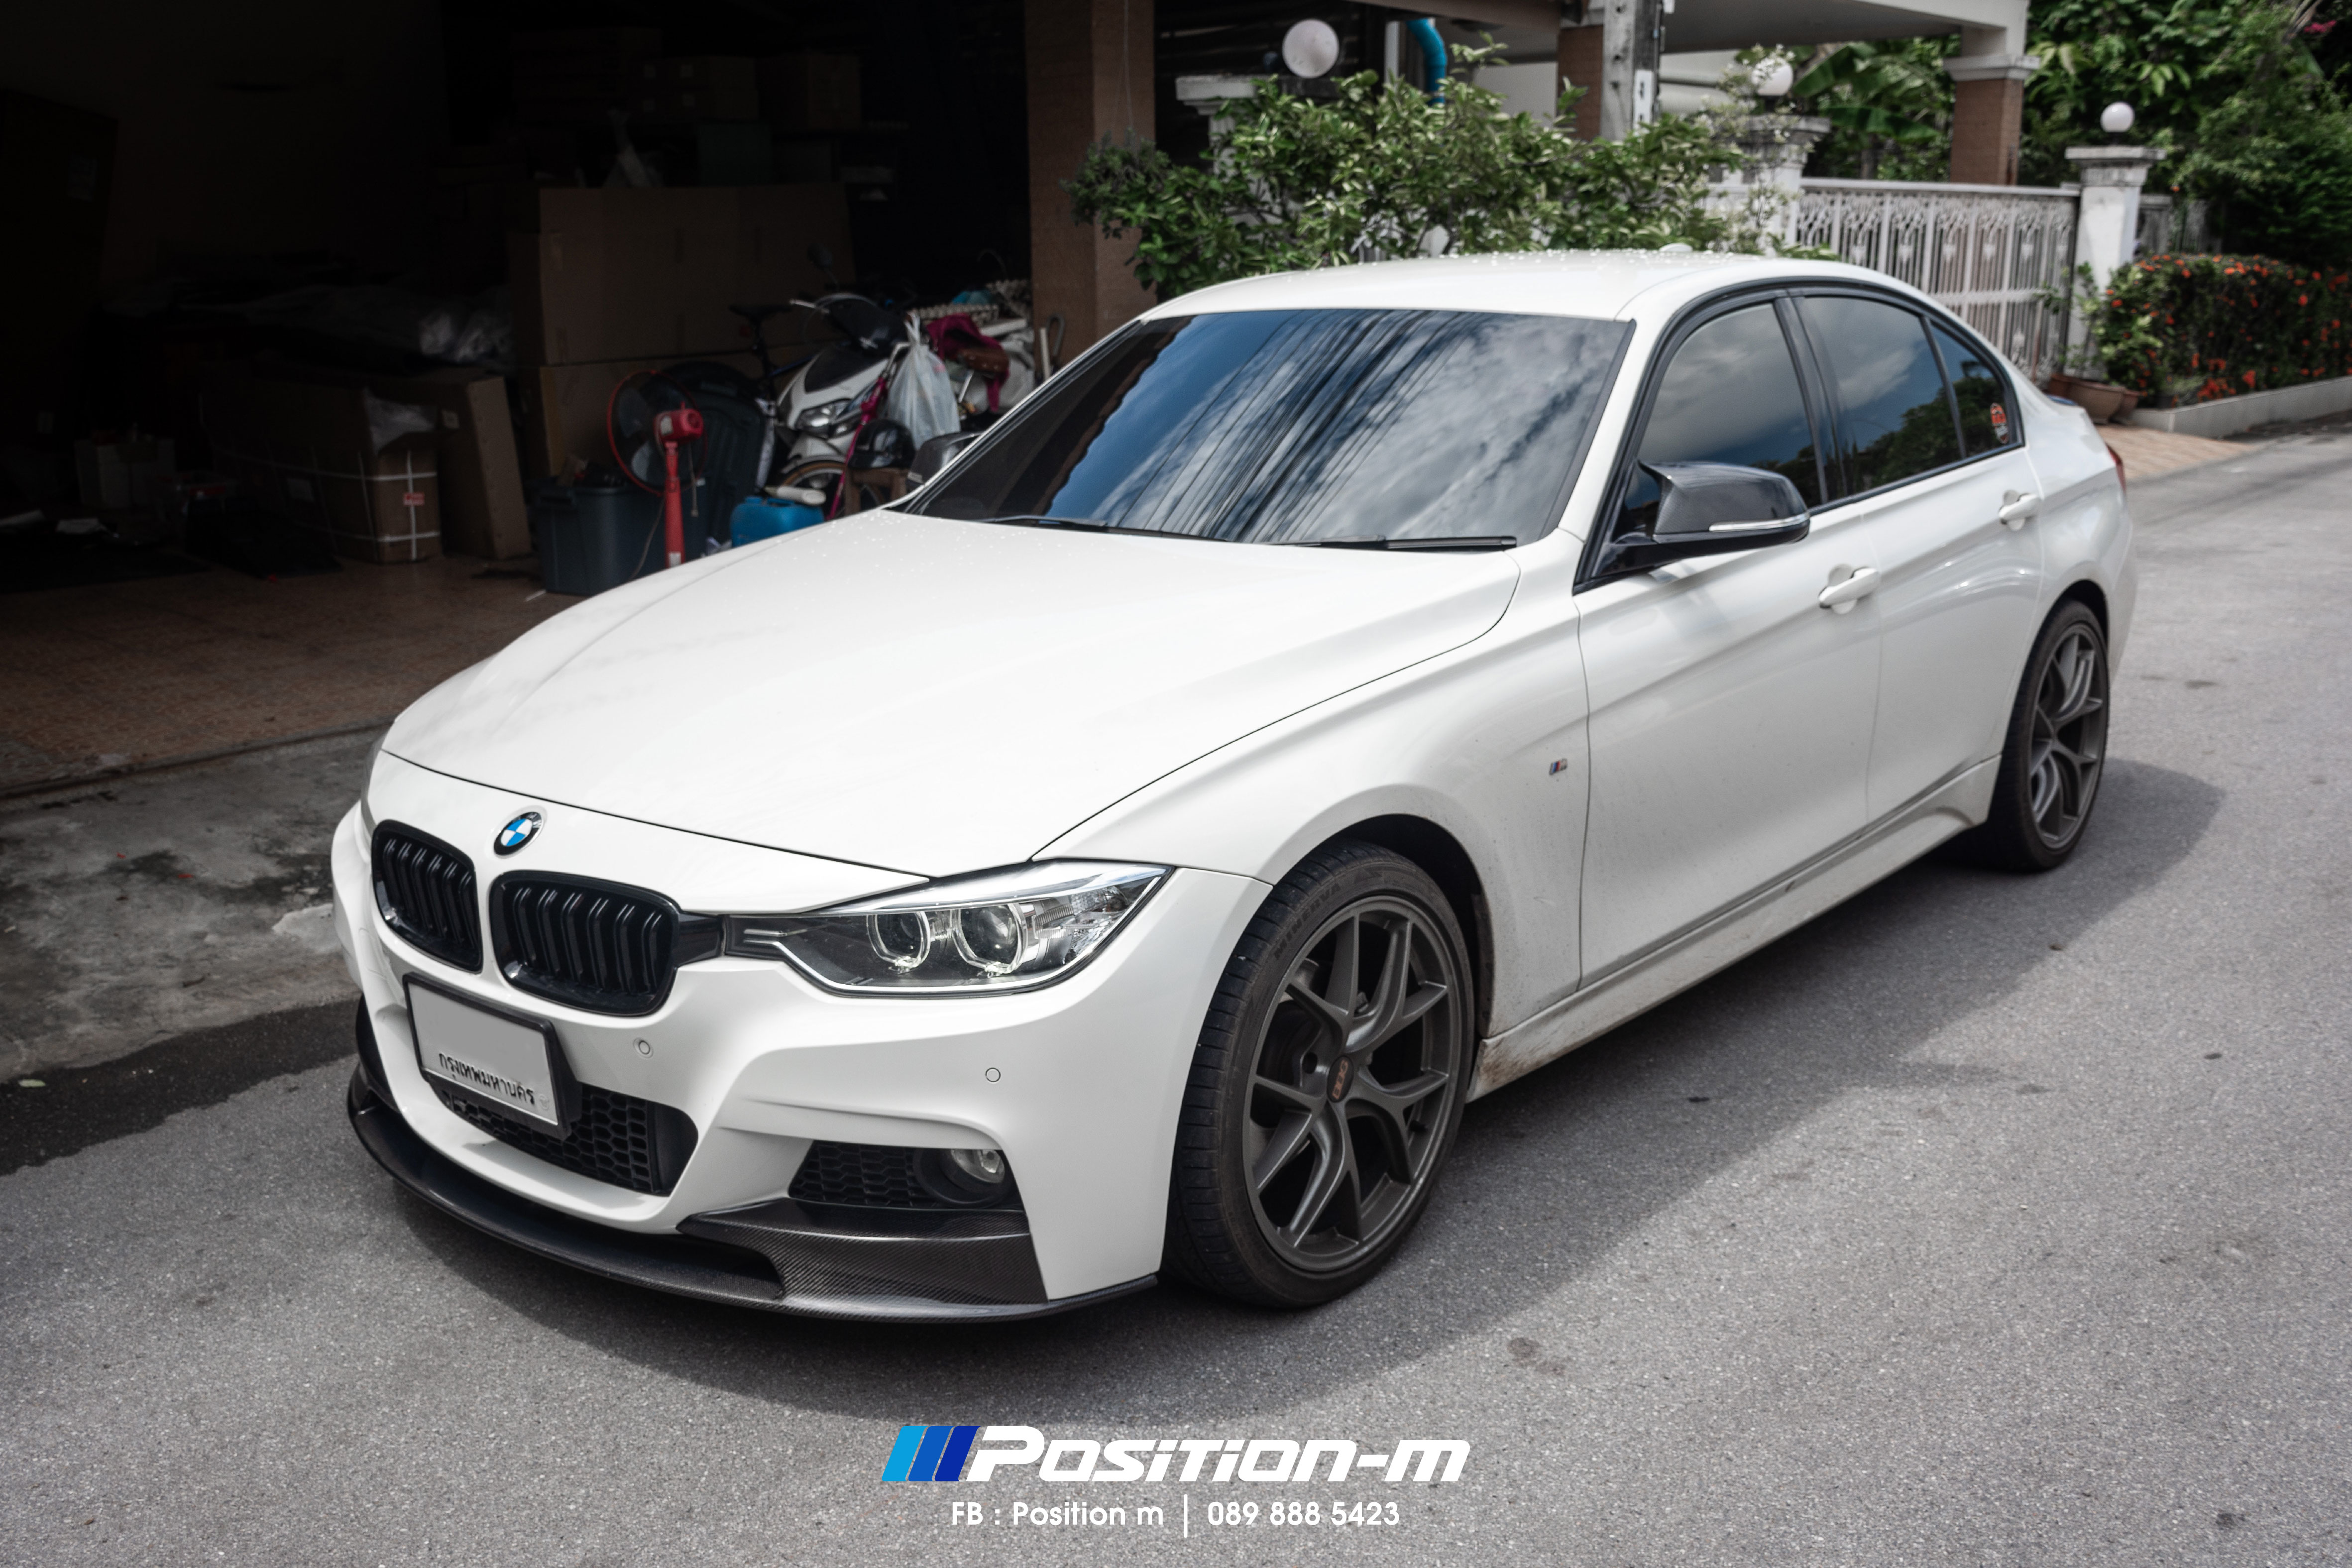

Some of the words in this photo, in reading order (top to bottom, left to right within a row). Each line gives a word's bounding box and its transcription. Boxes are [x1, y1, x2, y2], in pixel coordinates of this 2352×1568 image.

[1273, 883, 1341, 960] MINERVA
[438, 1052, 536, 1105] กรุงเทพมหานคร
